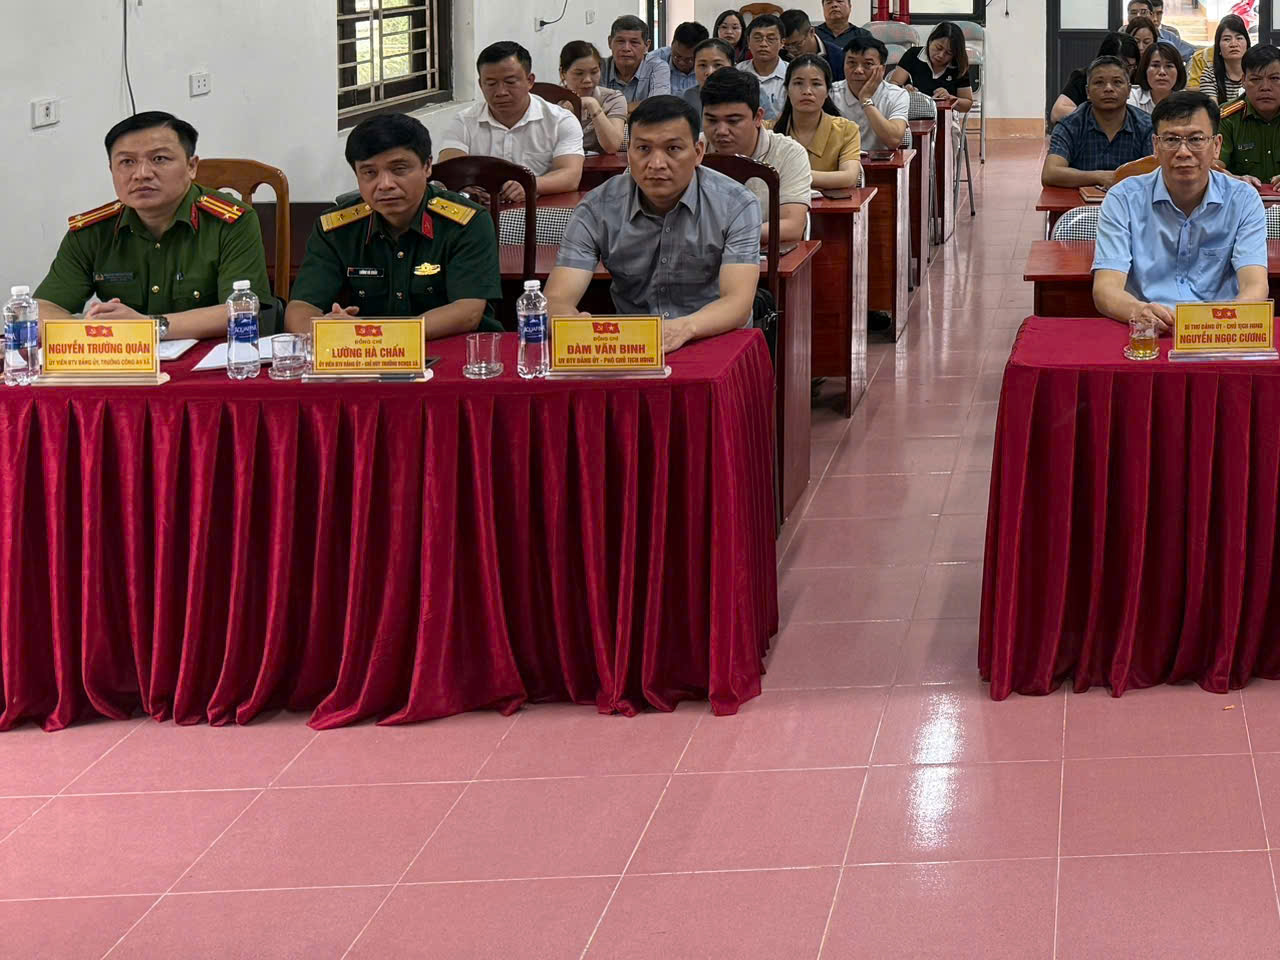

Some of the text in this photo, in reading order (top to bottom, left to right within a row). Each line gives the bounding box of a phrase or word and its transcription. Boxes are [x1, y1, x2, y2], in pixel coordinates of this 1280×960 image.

[365, 345, 377, 358] HÀ
[567, 343, 591, 354] ĐÀM
[595, 342, 616, 354] VĂN
